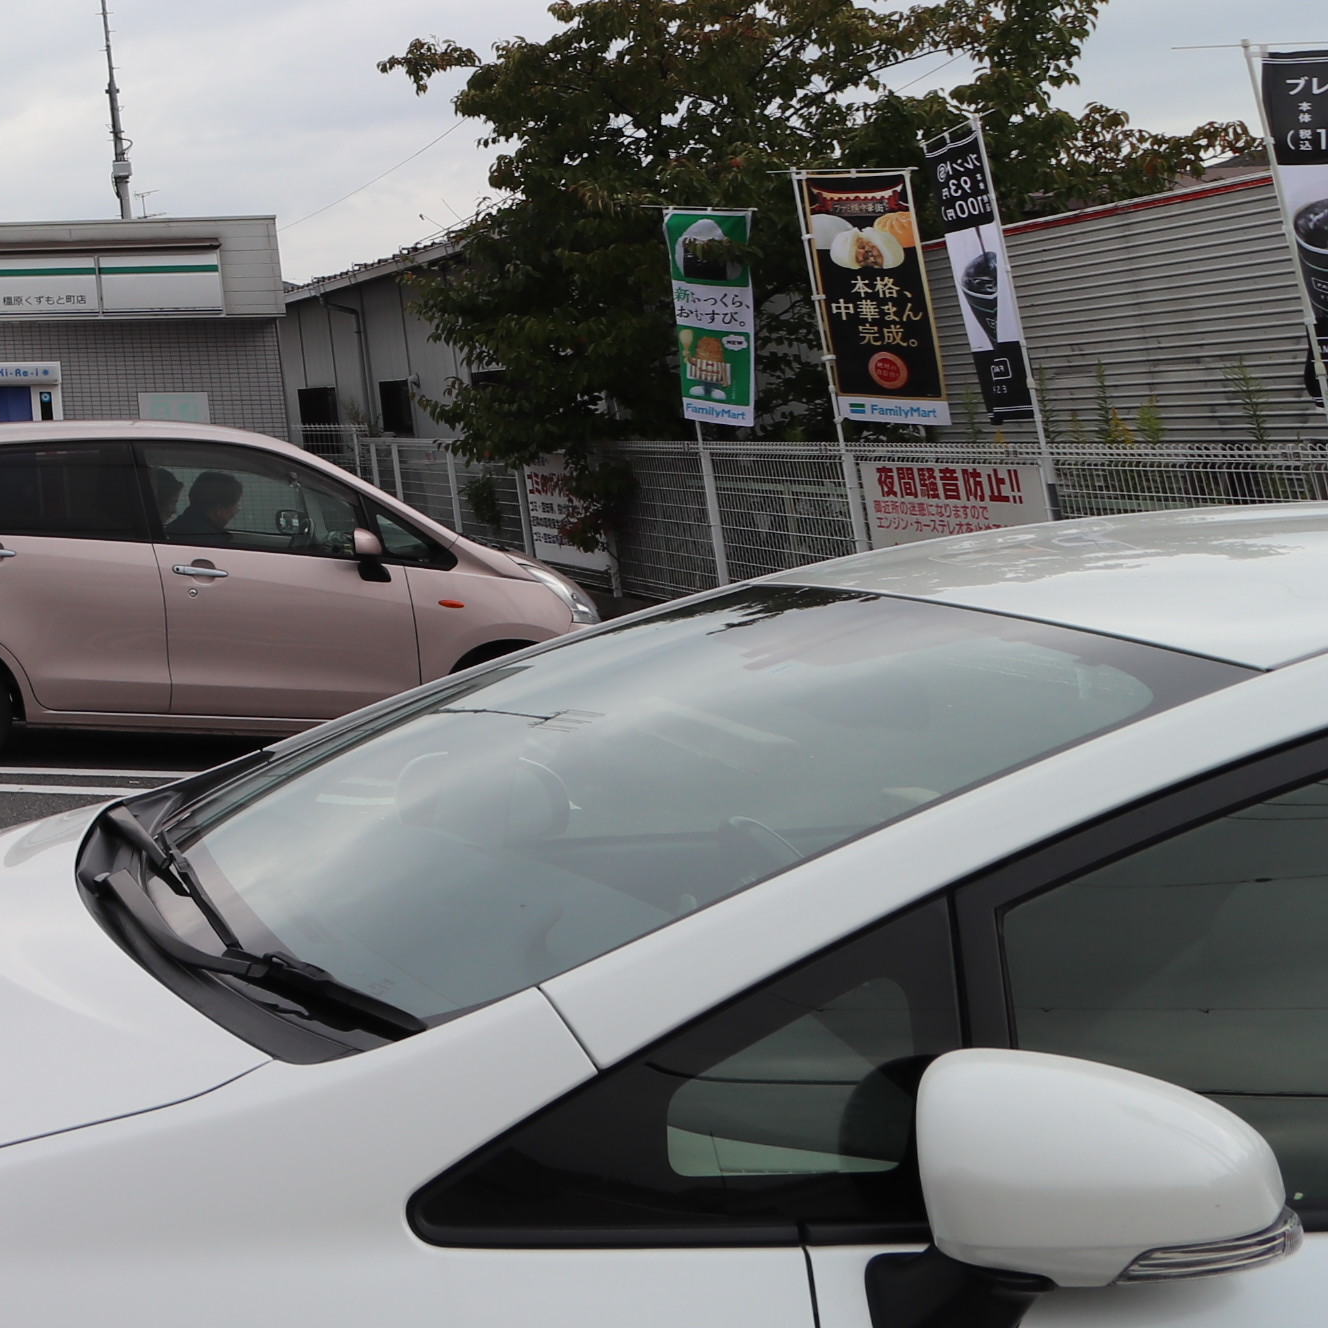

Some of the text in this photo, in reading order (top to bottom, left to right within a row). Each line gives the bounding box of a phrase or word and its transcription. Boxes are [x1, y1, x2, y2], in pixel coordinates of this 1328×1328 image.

[851, 275, 912, 298] 本格、
[2, 294, 87, 306] 橿原くずもと町店
[831, 298, 923, 322] 中華まん
[858, 324, 919, 347] 完成。
[686, 403, 747, 420] FamilyMart
[871, 404, 937, 419] FamilyMart
[876, 466, 1023, 505] 夜間騒音防止!!
